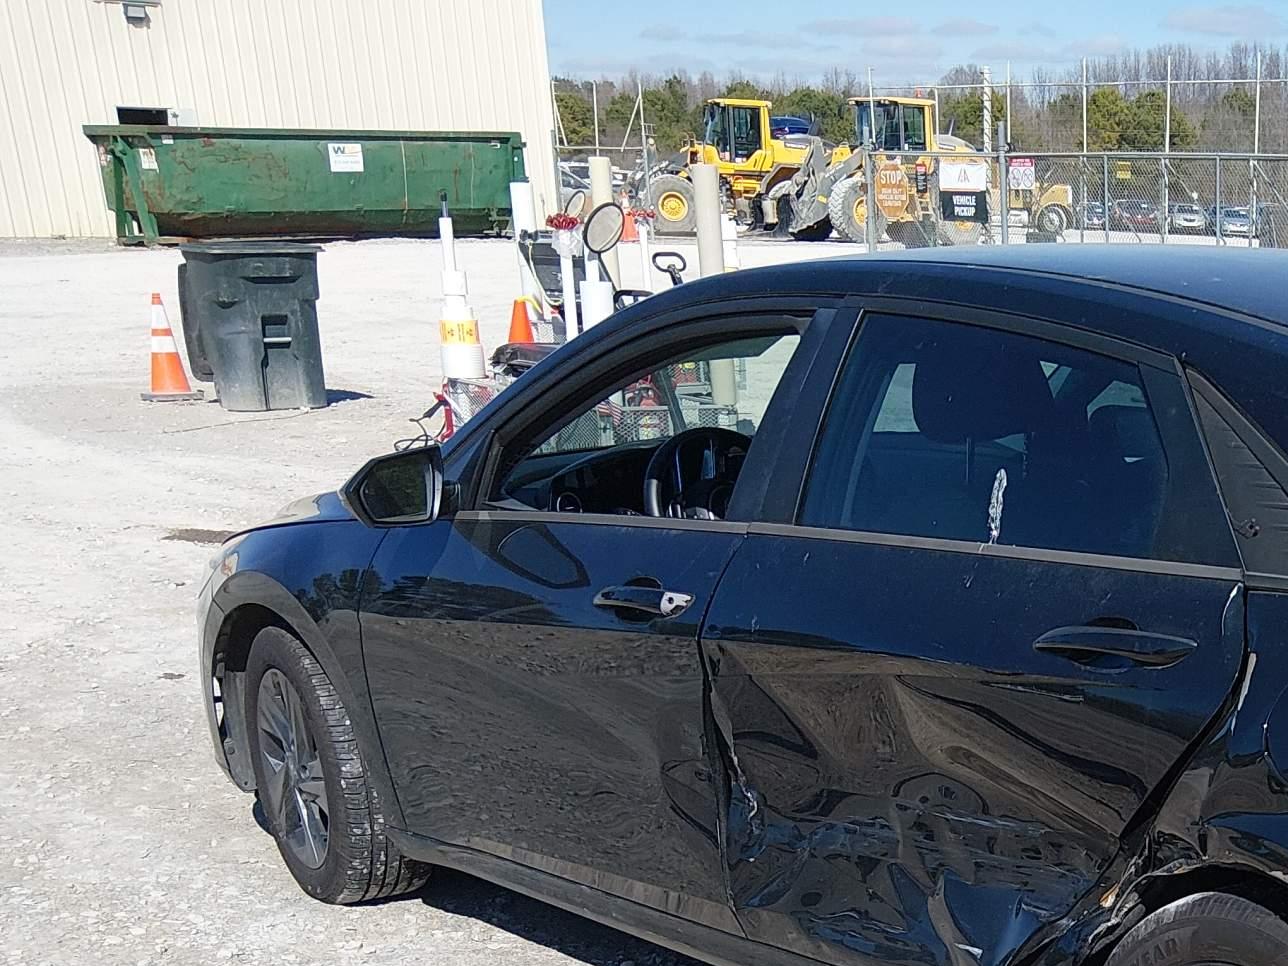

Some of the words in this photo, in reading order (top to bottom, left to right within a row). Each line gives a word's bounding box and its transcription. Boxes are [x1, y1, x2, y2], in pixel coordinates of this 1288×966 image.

[880, 170, 902, 185] STOP
[952, 195, 977, 206] VEHICLE
[954, 206, 977, 217] PICKUP
